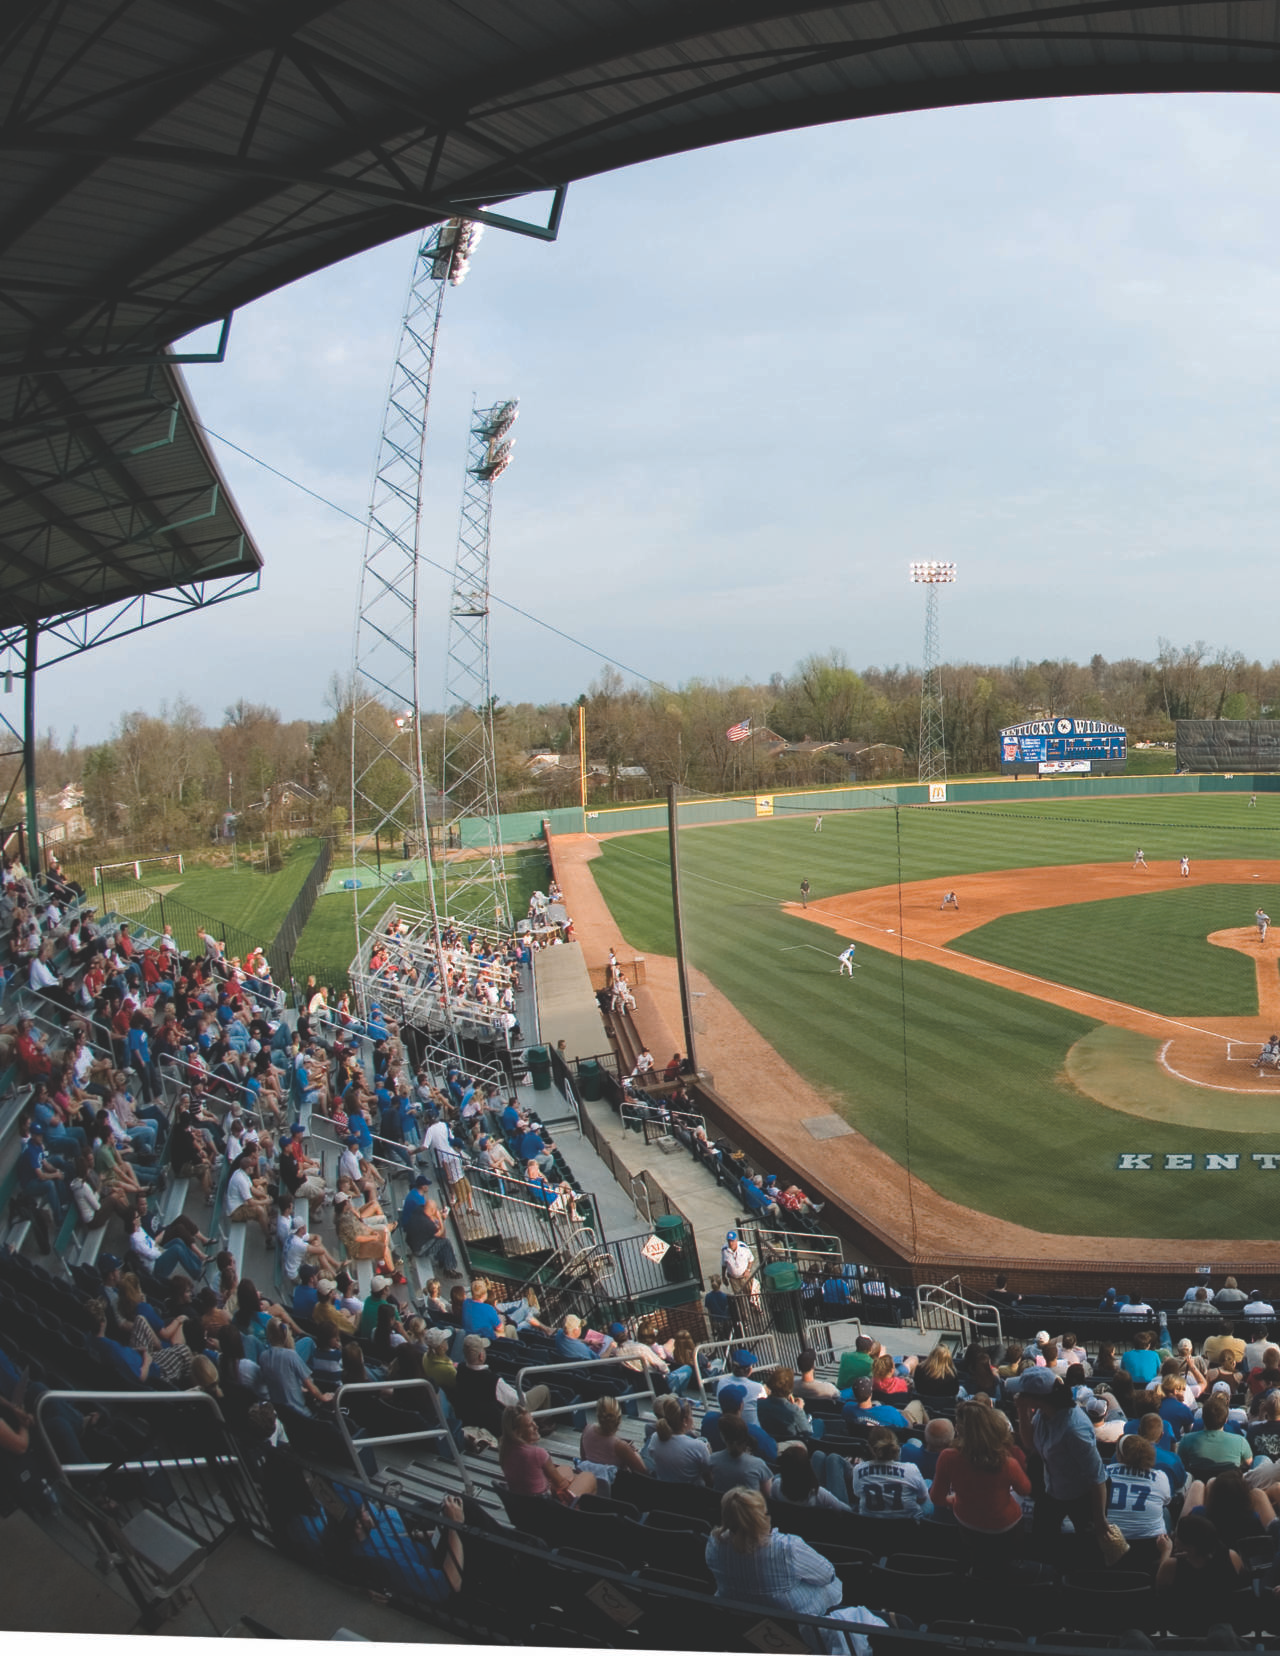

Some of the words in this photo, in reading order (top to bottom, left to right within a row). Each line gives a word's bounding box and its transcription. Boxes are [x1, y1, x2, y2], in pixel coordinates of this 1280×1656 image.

[1001, 721, 1055, 736] KENTUCKY
[1074, 720, 1126, 734] WILDCATS
[646, 1242, 665, 1253] EXIT
[858, 1464, 905, 1479] KENTUCKY
[863, 1483, 905, 1511] 07
[1110, 1481, 1152, 1512] 07
